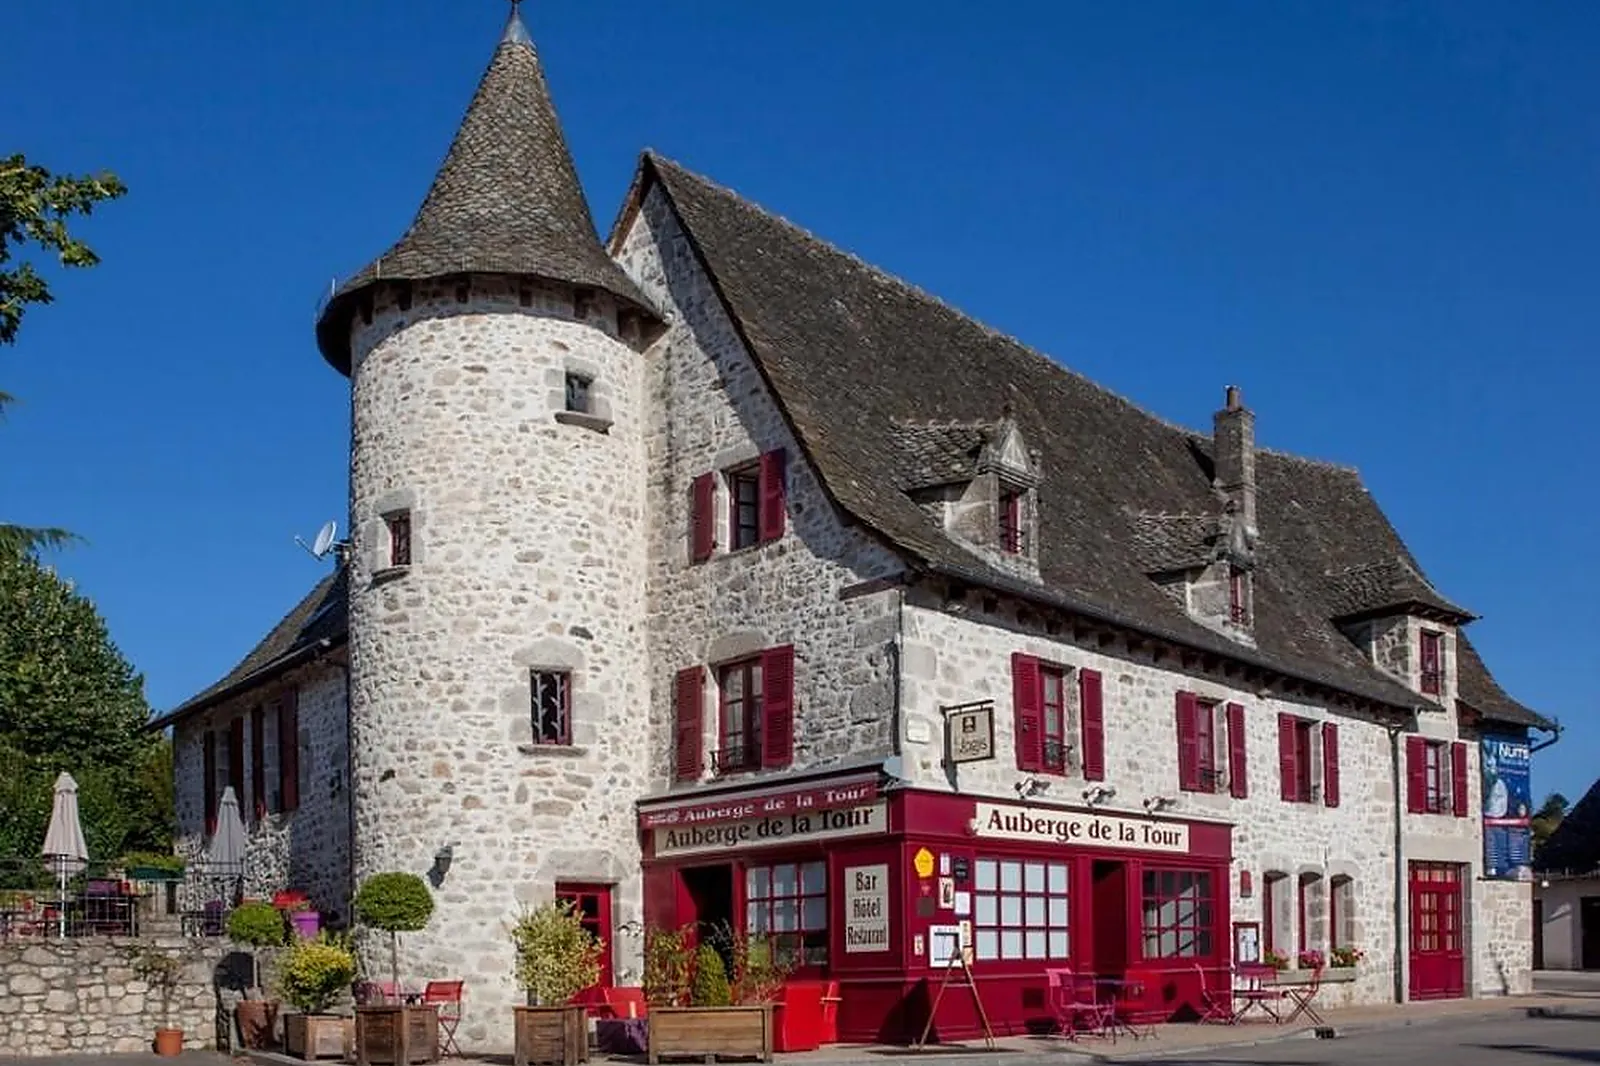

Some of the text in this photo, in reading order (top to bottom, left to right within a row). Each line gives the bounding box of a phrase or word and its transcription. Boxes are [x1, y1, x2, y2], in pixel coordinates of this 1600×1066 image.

[684, 804, 755, 822] Auberge
[764, 799, 786, 811] de
[796, 794, 813, 807] la
[825, 787, 869, 803] Tour
[665, 807, 874, 849] Auberge de la Tour
[987, 809, 1182, 846] Auberge de la Tour
[856, 871, 877, 891] Bar
[854, 897, 881, 918] Hôtel
